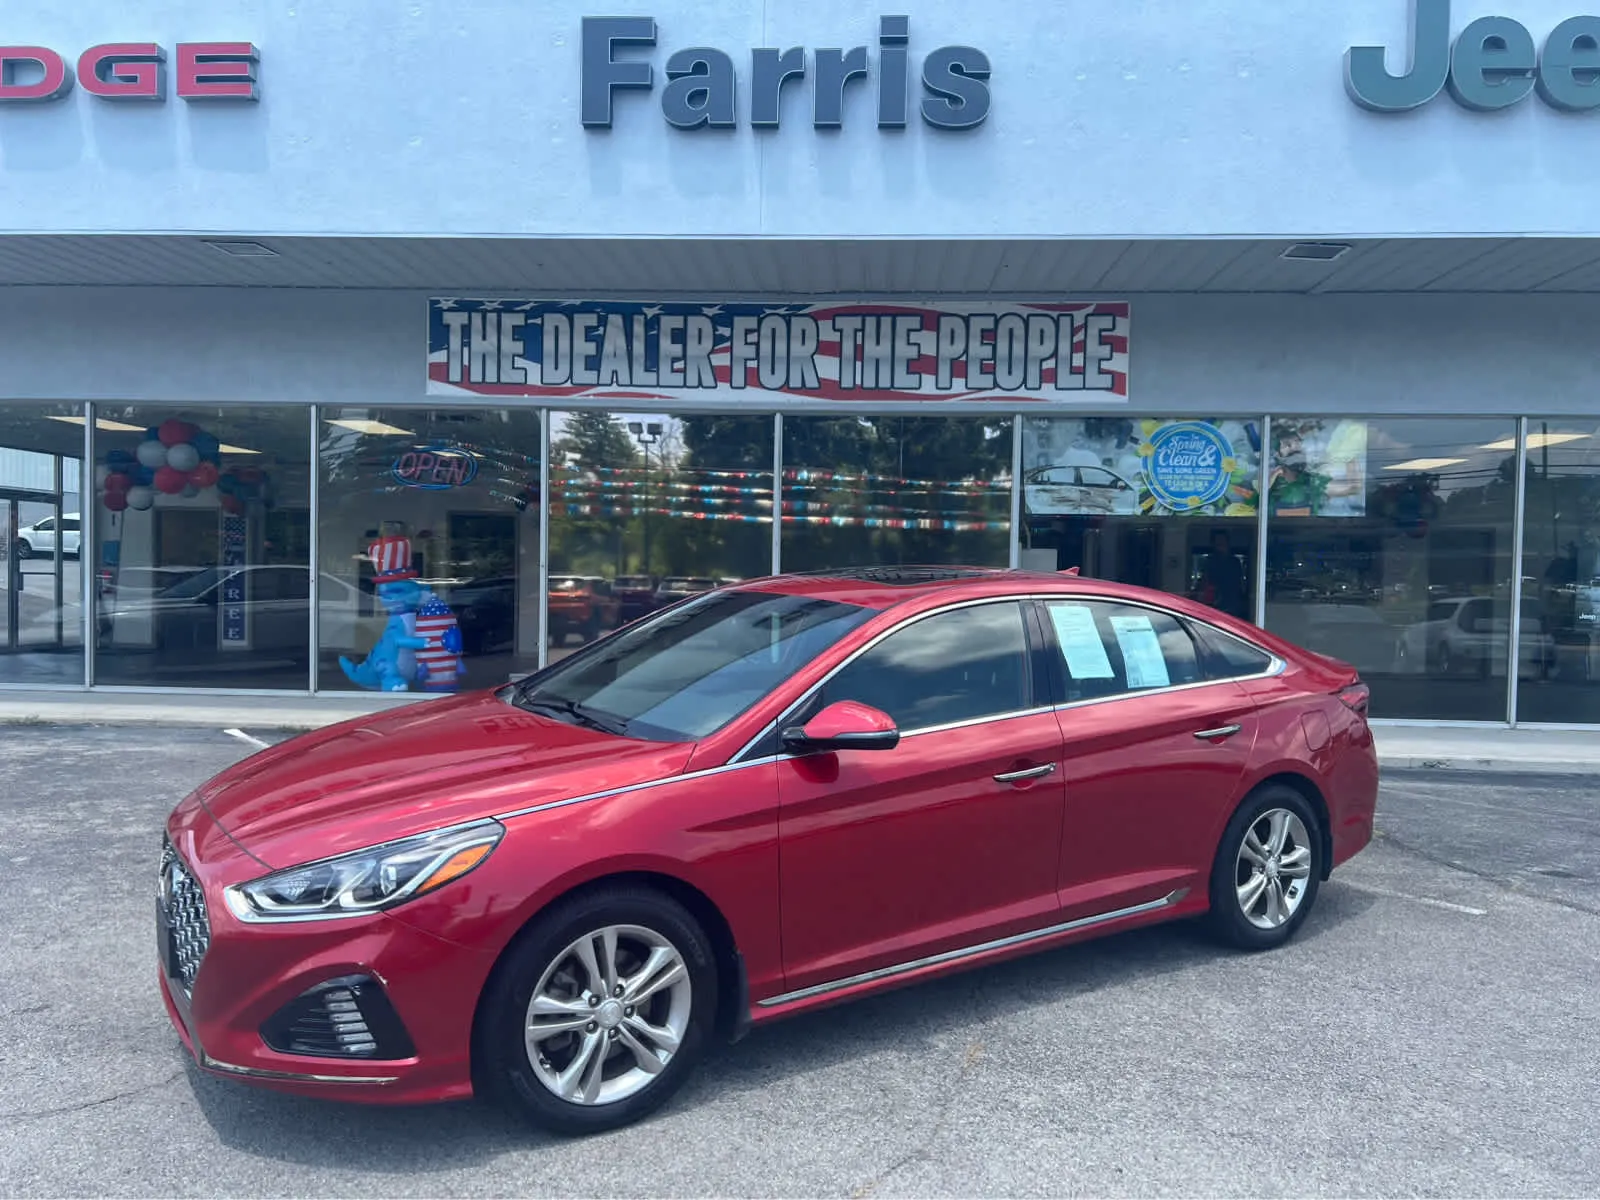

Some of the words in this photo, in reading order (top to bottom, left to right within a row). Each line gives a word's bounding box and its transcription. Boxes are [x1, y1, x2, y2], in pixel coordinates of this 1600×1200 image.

[0, 42, 260, 103] DGE
[580, 15, 992, 129] Farris
[442, 311, 528, 384] THE
[540, 312, 718, 389] DEALER
[730, 312, 821, 390] FOR
[832, 313, 924, 390] THE
[935, 313, 1116, 391] PEOPLE
[1157, 446, 1197, 467] Clean
[1198, 445, 1217, 467] &
[1168, 435, 1206, 454] Spring
[399, 452, 468, 486] OPEN
